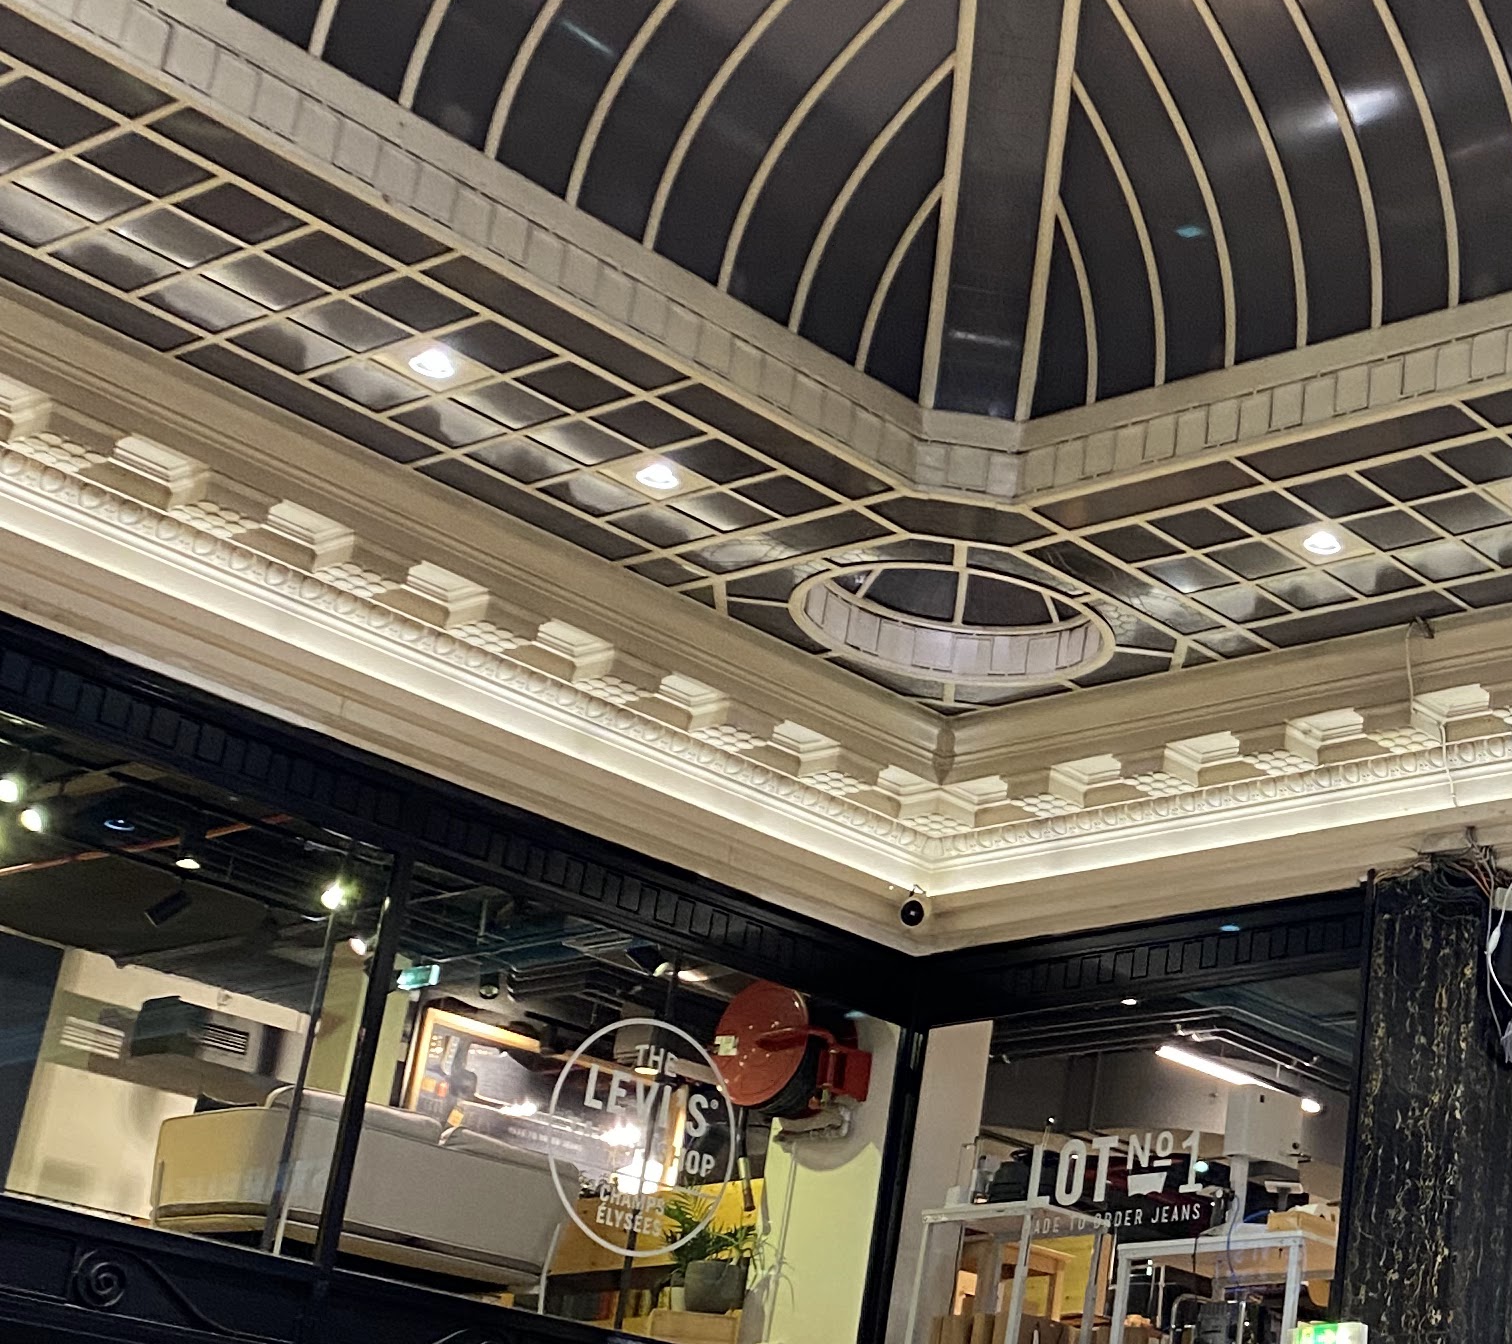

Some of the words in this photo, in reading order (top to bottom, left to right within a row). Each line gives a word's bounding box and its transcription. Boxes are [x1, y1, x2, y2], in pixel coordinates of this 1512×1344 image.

[635, 1043, 678, 1078] THE
[1026, 1135, 1119, 1207] LOT
[600, 1185, 666, 1216] CHAMPS
[1031, 1216, 1061, 1235] ADE
[1150, 1203, 1202, 1225] JEANS
